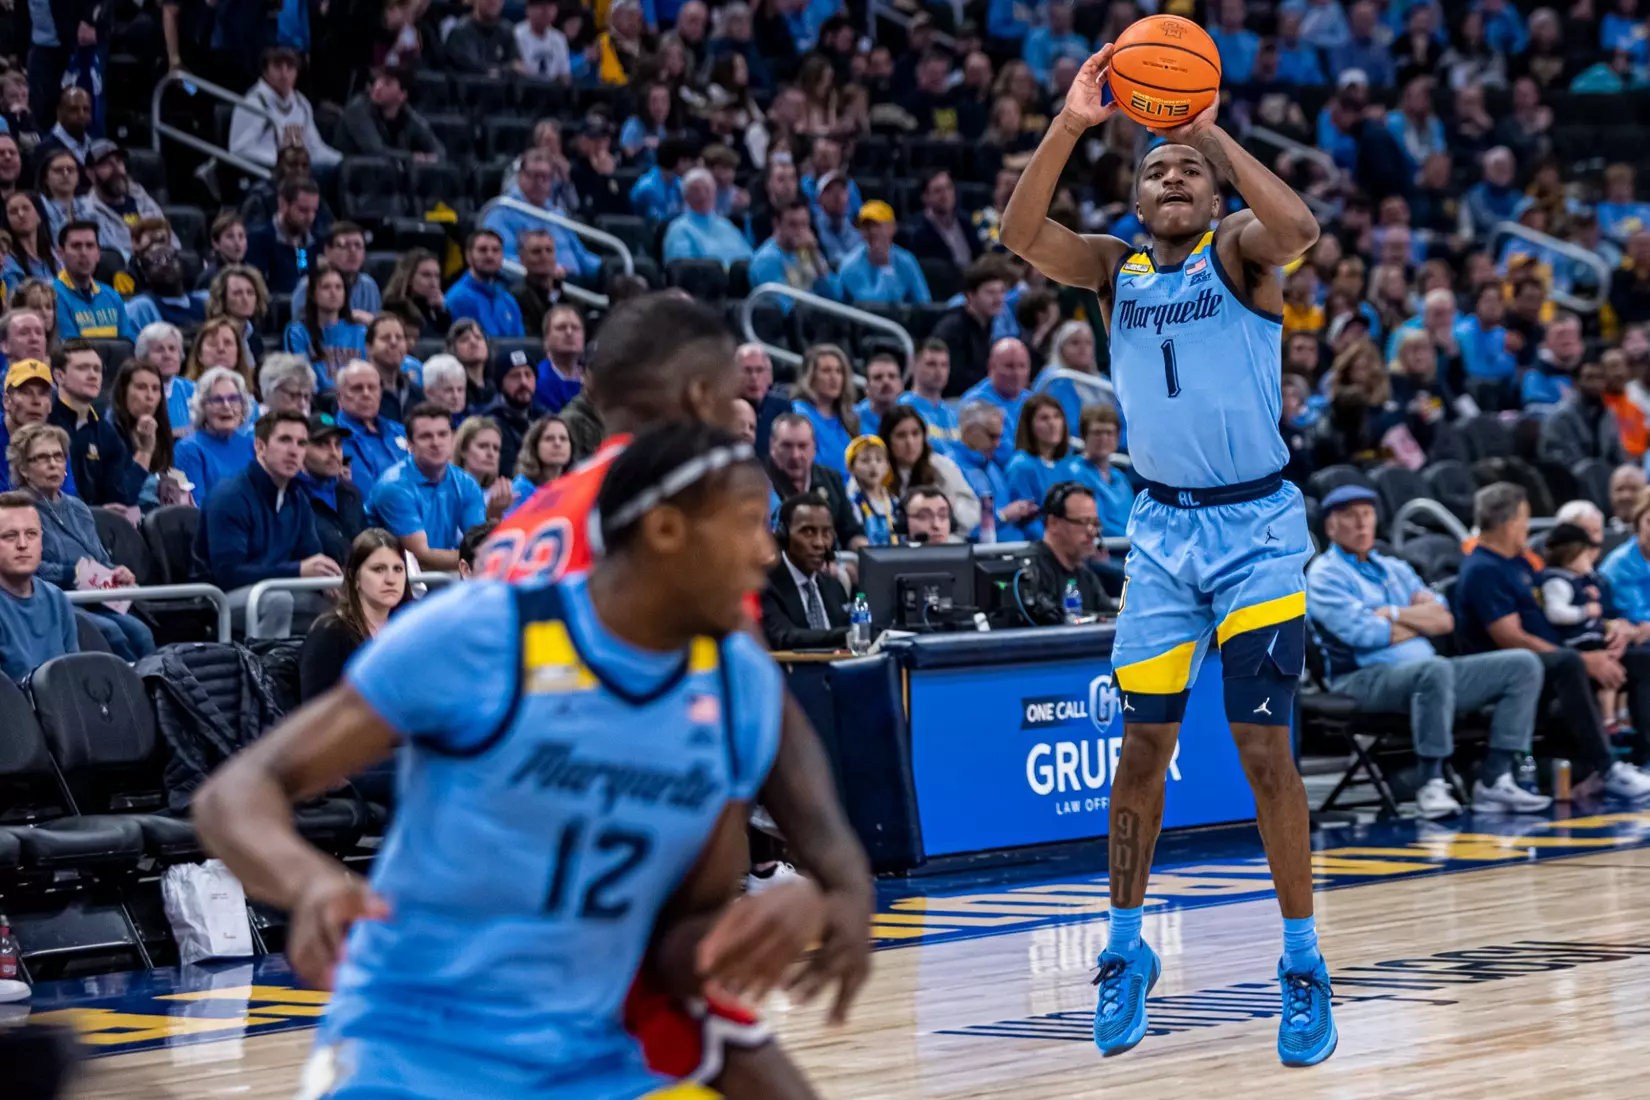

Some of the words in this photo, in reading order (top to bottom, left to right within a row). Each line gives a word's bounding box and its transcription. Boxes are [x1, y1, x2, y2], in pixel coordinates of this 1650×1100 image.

[1131, 94, 1190, 117] ELITE
[1119, 288, 1223, 335] Marquette
[1160, 339, 1182, 398] 1
[1026, 702, 1055, 723] ONE
[1055, 700, 1089, 720] CALL
[1056, 800, 1081, 815] LAW
[541, 817, 655, 920] 12
